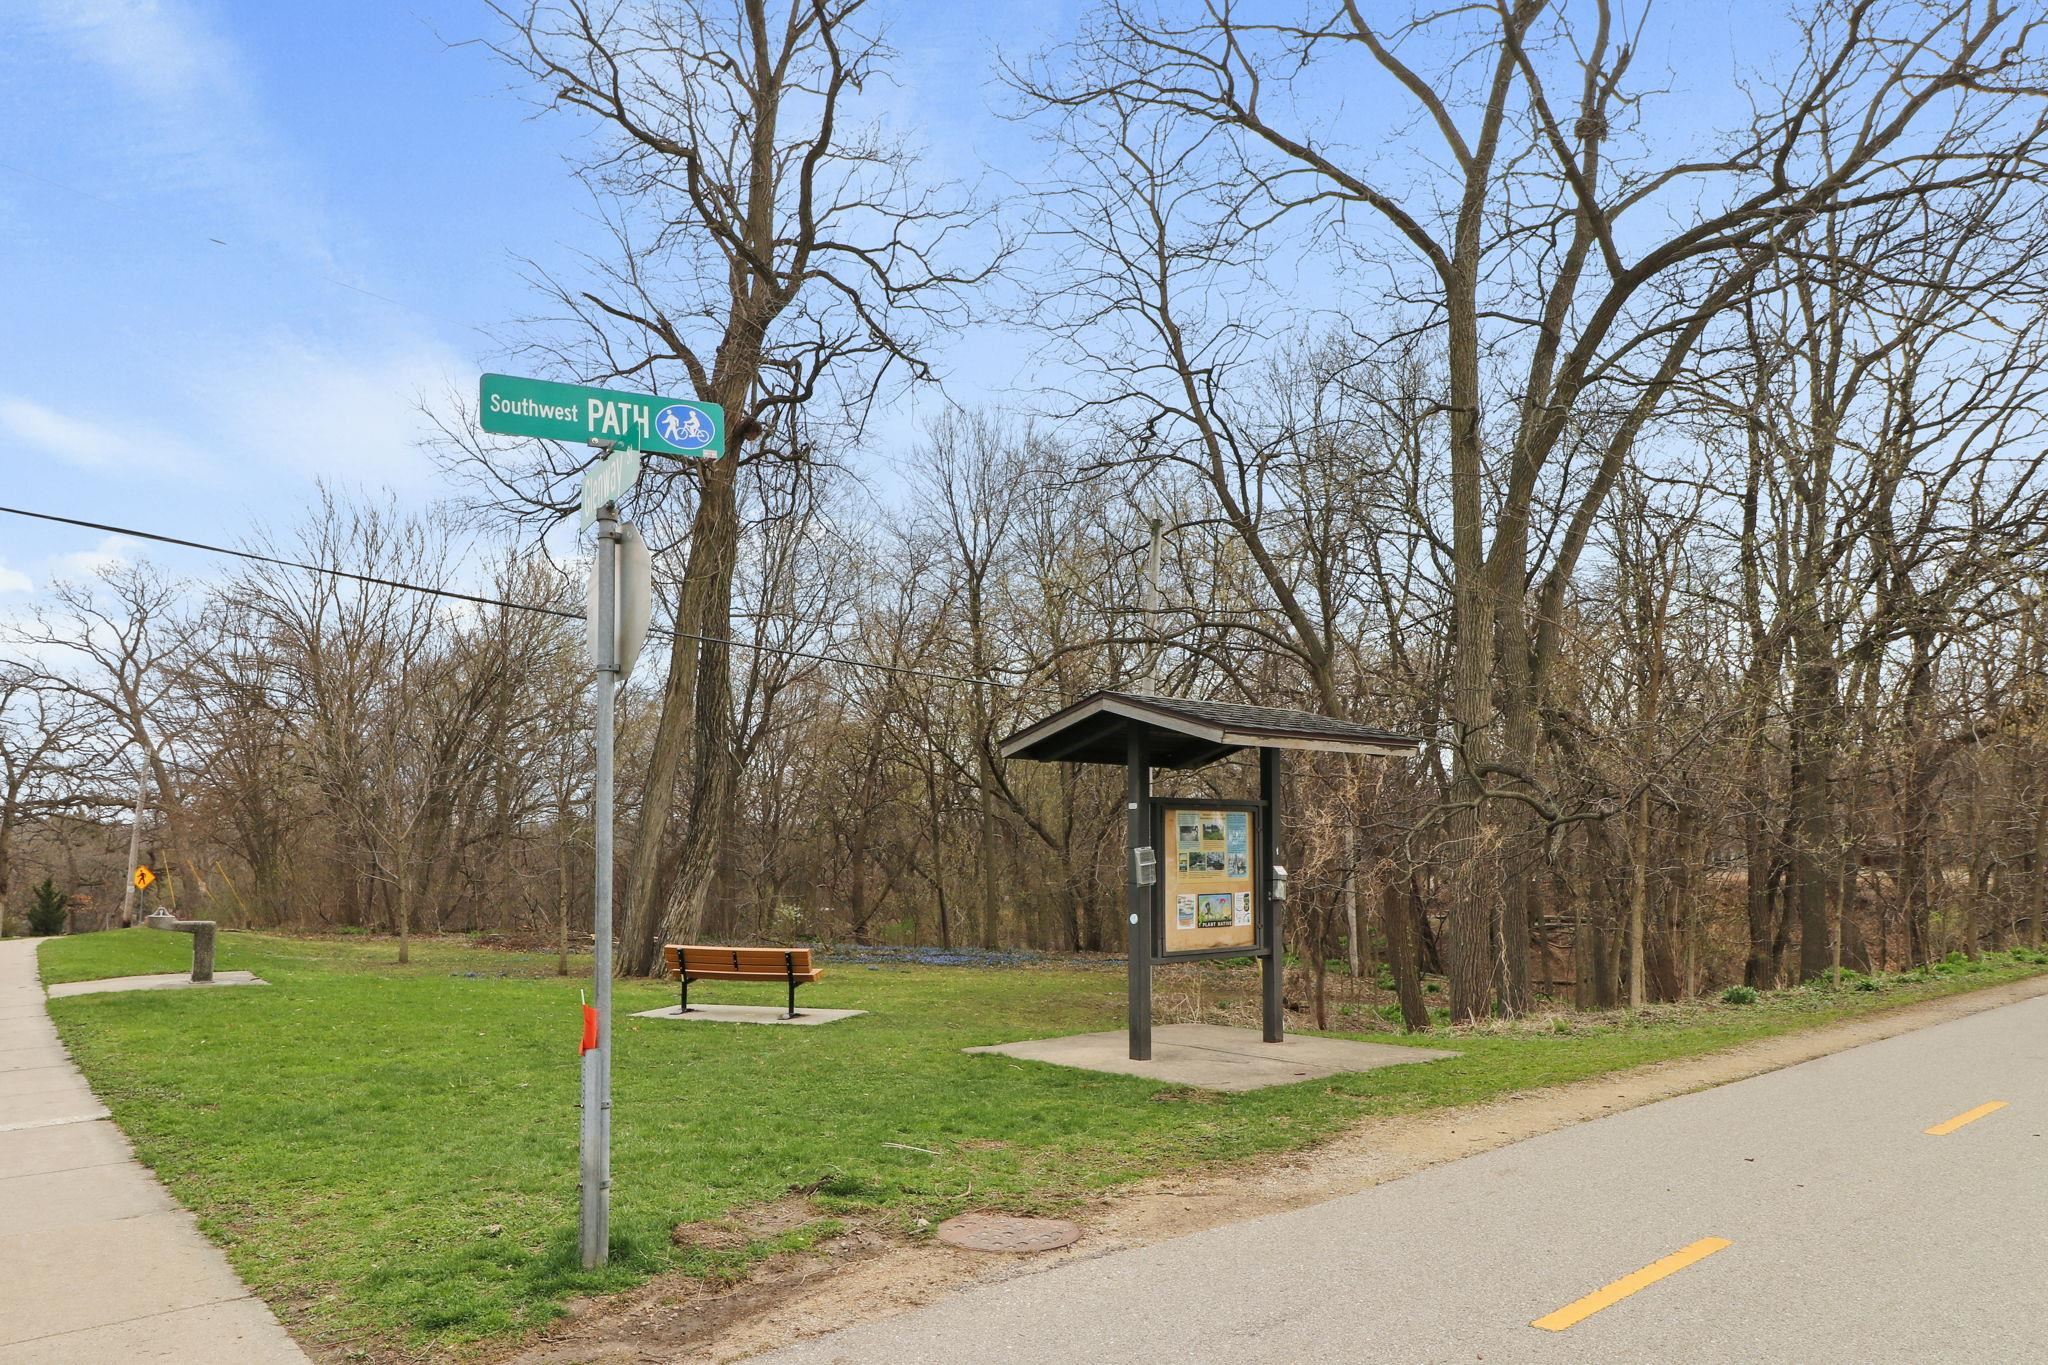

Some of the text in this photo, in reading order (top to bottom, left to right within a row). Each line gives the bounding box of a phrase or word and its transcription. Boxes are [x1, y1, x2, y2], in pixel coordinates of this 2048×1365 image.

[490, 394, 649, 439] Southwest PATH
[585, 453, 623, 518] Glenway
